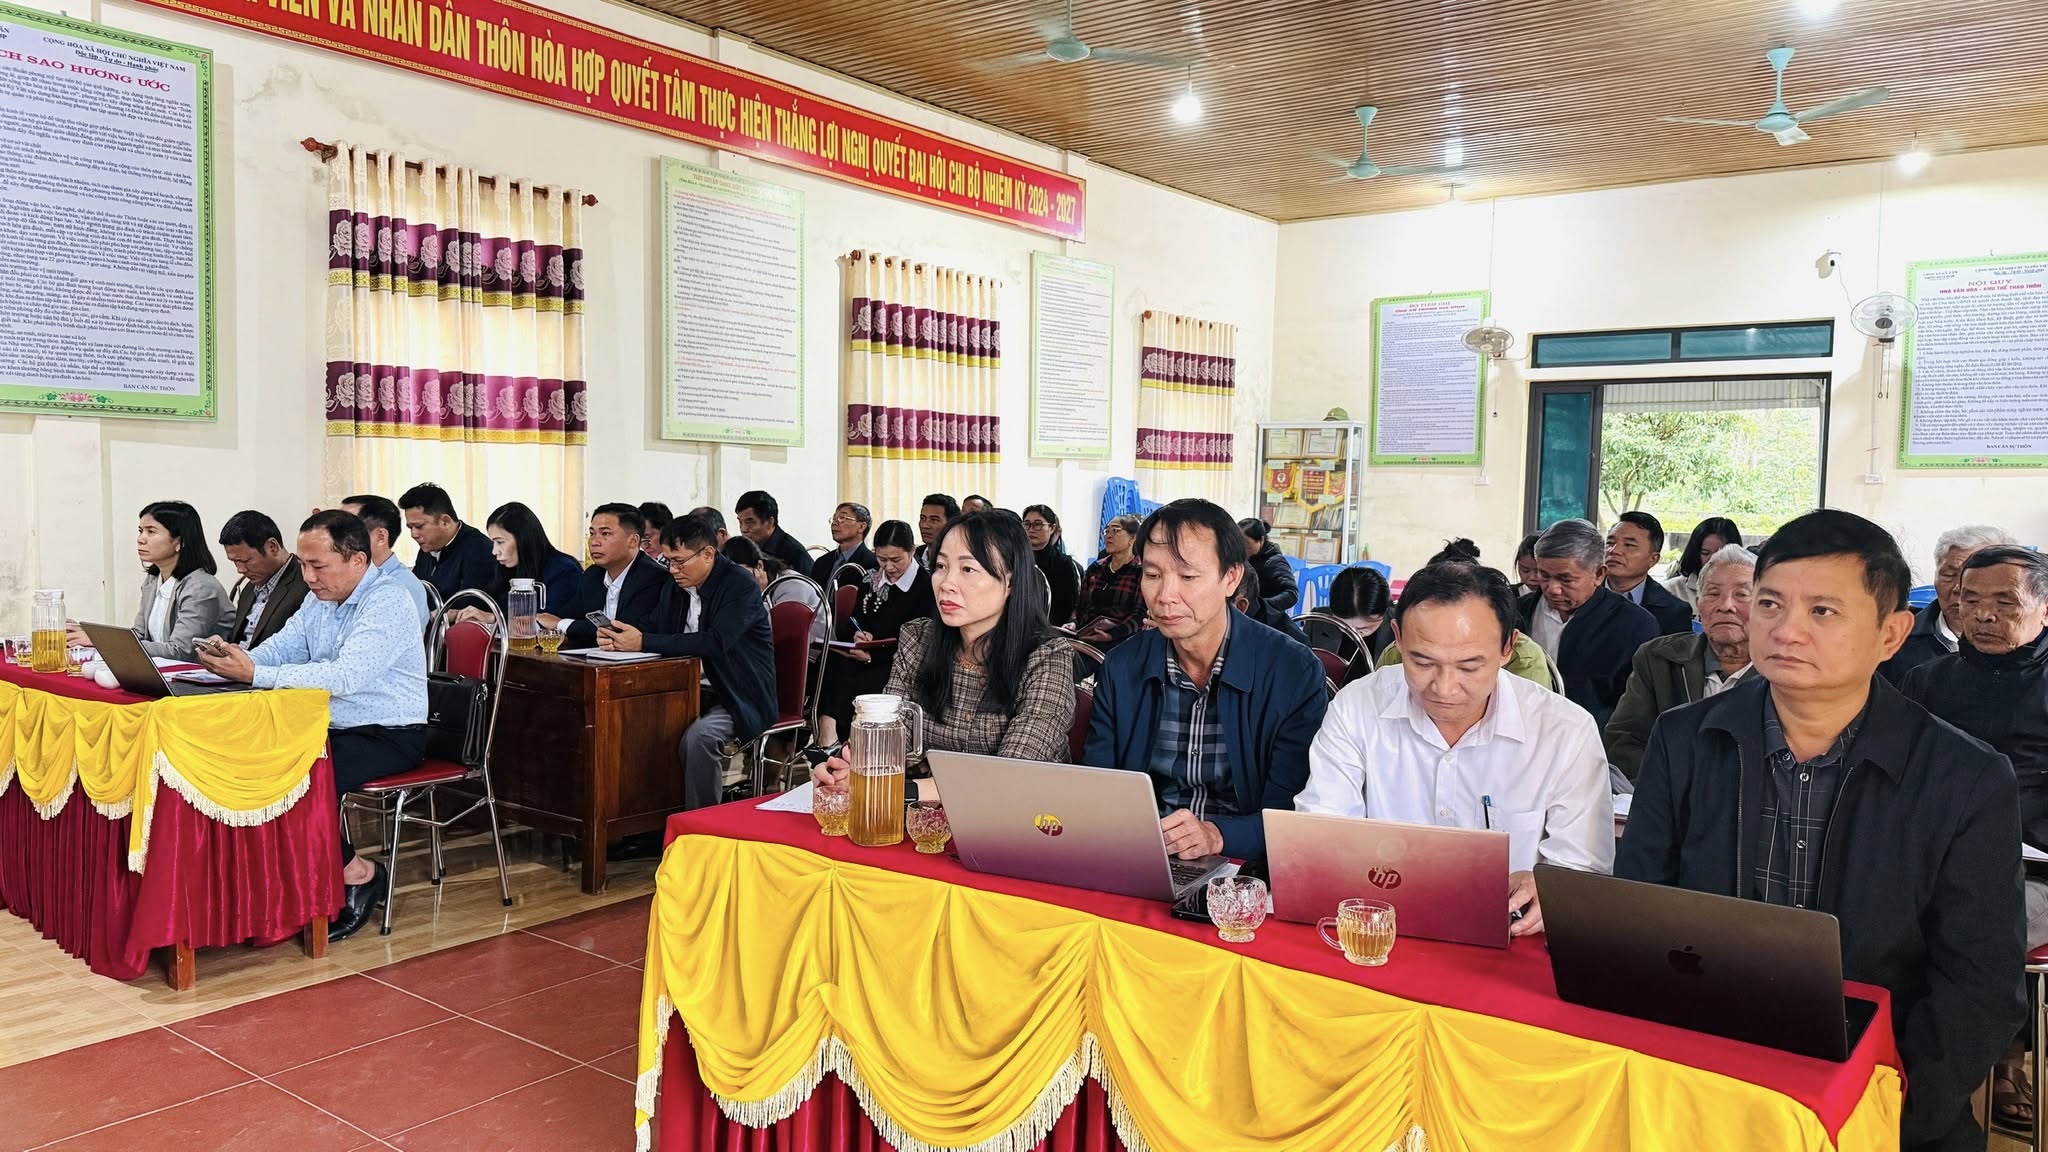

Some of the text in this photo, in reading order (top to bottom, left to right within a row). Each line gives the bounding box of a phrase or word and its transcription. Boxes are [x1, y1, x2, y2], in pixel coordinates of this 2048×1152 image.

[128, 55, 152, 64] NGHĨA
[27, 55, 64, 69] SAO
[70, 64, 132, 84] HƯƠNG
[137, 78, 170, 92] ƯỚC
[430, 3, 471, 61] DÂN
[476, 19, 526, 76] THÔN
[531, 29, 567, 87] HÒA
[572, 47, 605, 103] HỢP
[610, 57, 660, 112] QUYẾT
[664, 68, 696, 122] TÂM
[700, 84, 736, 138] THỰC
[740, 93, 772, 148] HIỆN
[775, 98, 817, 156] THẮNG
[820, 121, 838, 168] LỢI
[842, 128, 870, 178] NGHỊ
[872, 133, 907, 180] QUYẾT
[908, 148, 926, 192] ĐẠI
[930, 150, 946, 196] HỘI
[949, 159, 966, 196] CHI
[968, 161, 981, 207] BỘ
[983, 168, 1013, 212] NHIỆM
[1014, 175, 1027, 212] KỲ
[1028, 184, 1049, 218] 2024
[1056, 195, 1077, 225] 2027
[1034, 814, 1064, 838] hp
[1367, 866, 1402, 890] hp
